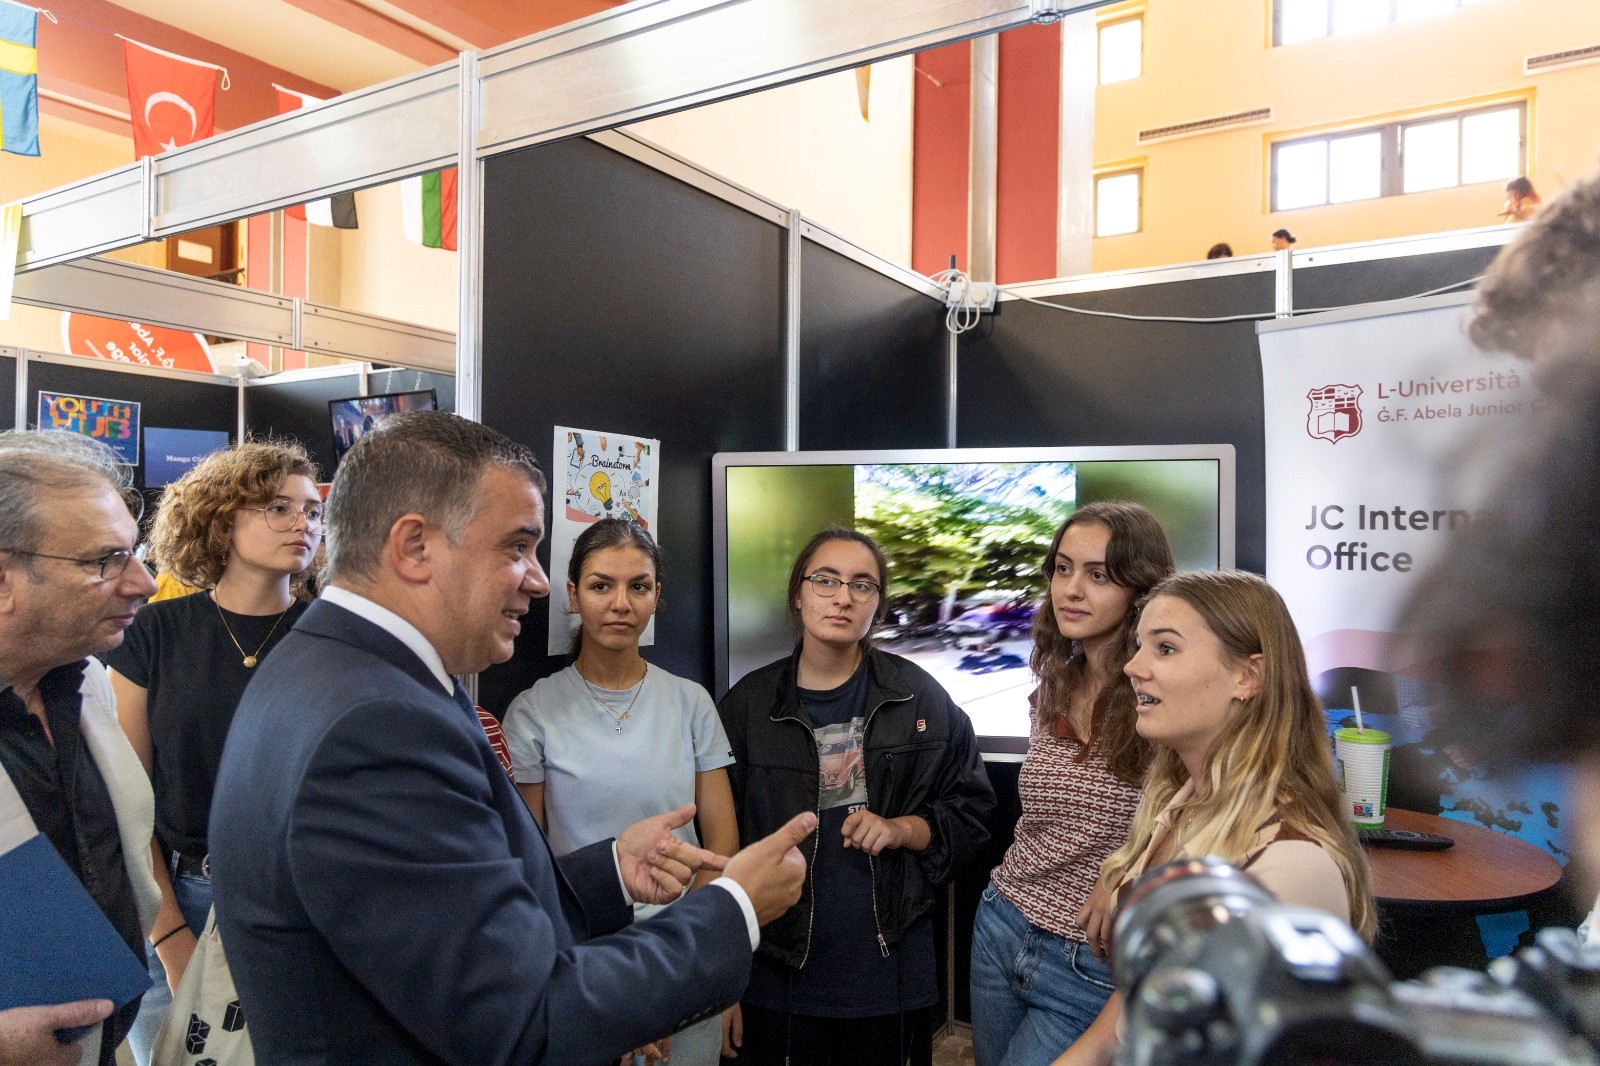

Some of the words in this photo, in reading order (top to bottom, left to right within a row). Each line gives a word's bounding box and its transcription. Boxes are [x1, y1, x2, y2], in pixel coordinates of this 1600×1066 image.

[1378, 368, 1521, 399] L-Università
[43, 395, 131, 419] YOUTH
[1377, 406, 1408, 422] Ġ.F.
[1413, 403, 1462, 420] Abela
[50, 412, 131, 440] HUB
[590, 454, 632, 471] Brainstorm
[1305, 504, 1345, 530] JC
[1359, 504, 1474, 531] Intern
[1306, 541, 1413, 573] Office
